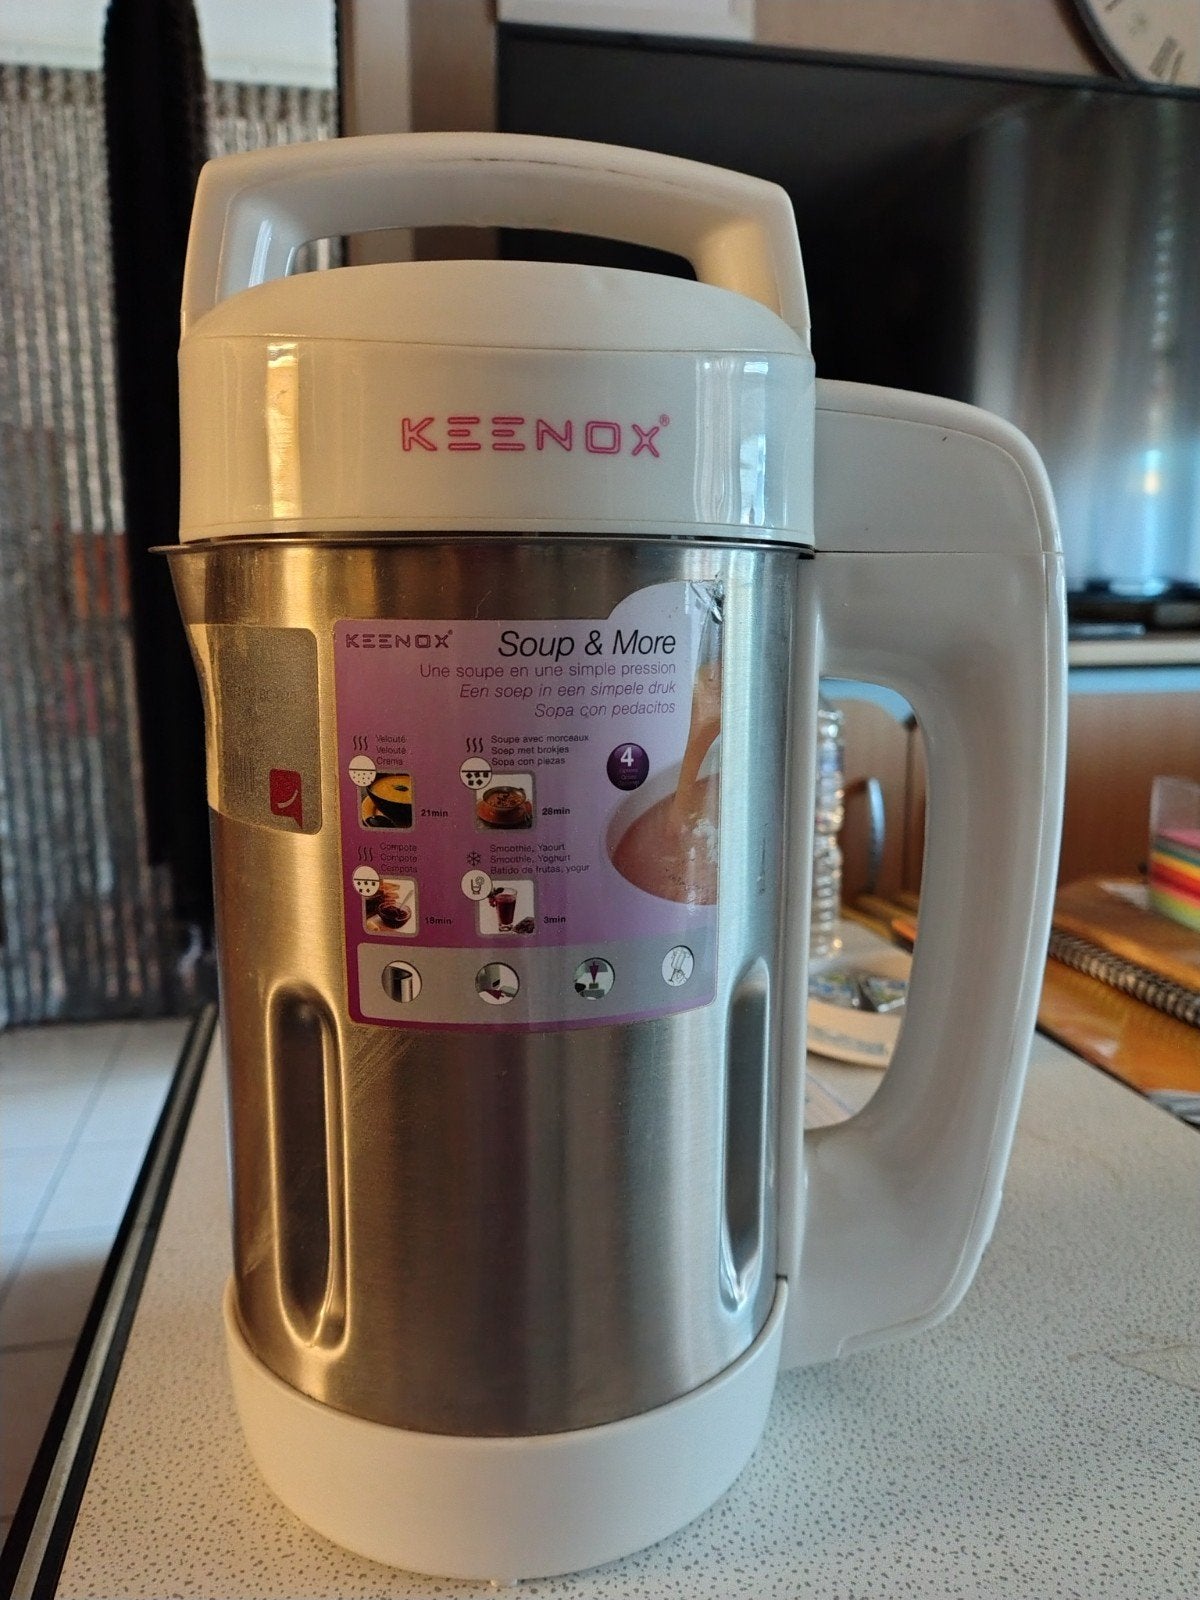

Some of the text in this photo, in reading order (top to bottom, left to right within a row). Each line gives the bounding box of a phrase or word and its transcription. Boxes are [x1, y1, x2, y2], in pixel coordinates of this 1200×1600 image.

[498, 629, 676, 662] Soup & More
[420, 661, 676, 680] Une soupe en une simple pression
[459, 680, 676, 699] Een soep in een simpele druk
[534, 701, 676, 719] Sopa con pedacitos
[491, 734, 590, 744] Soupe avec morceaux
[491, 747, 515, 755] Soep
[537, 746, 570, 755] brokjes
[491, 758, 515, 766] Sopa
[537, 757, 566, 766] piezas
[620, 746, 635, 767] 4
[420, 808, 449, 818] 21min
[542, 807, 571, 816] 28min
[489, 843, 566, 853] Smoothie, Yaourt
[537, 854, 571, 864] Yoghurt
[565, 864, 590, 873] yogur
[543, 915, 567, 924] 3min
